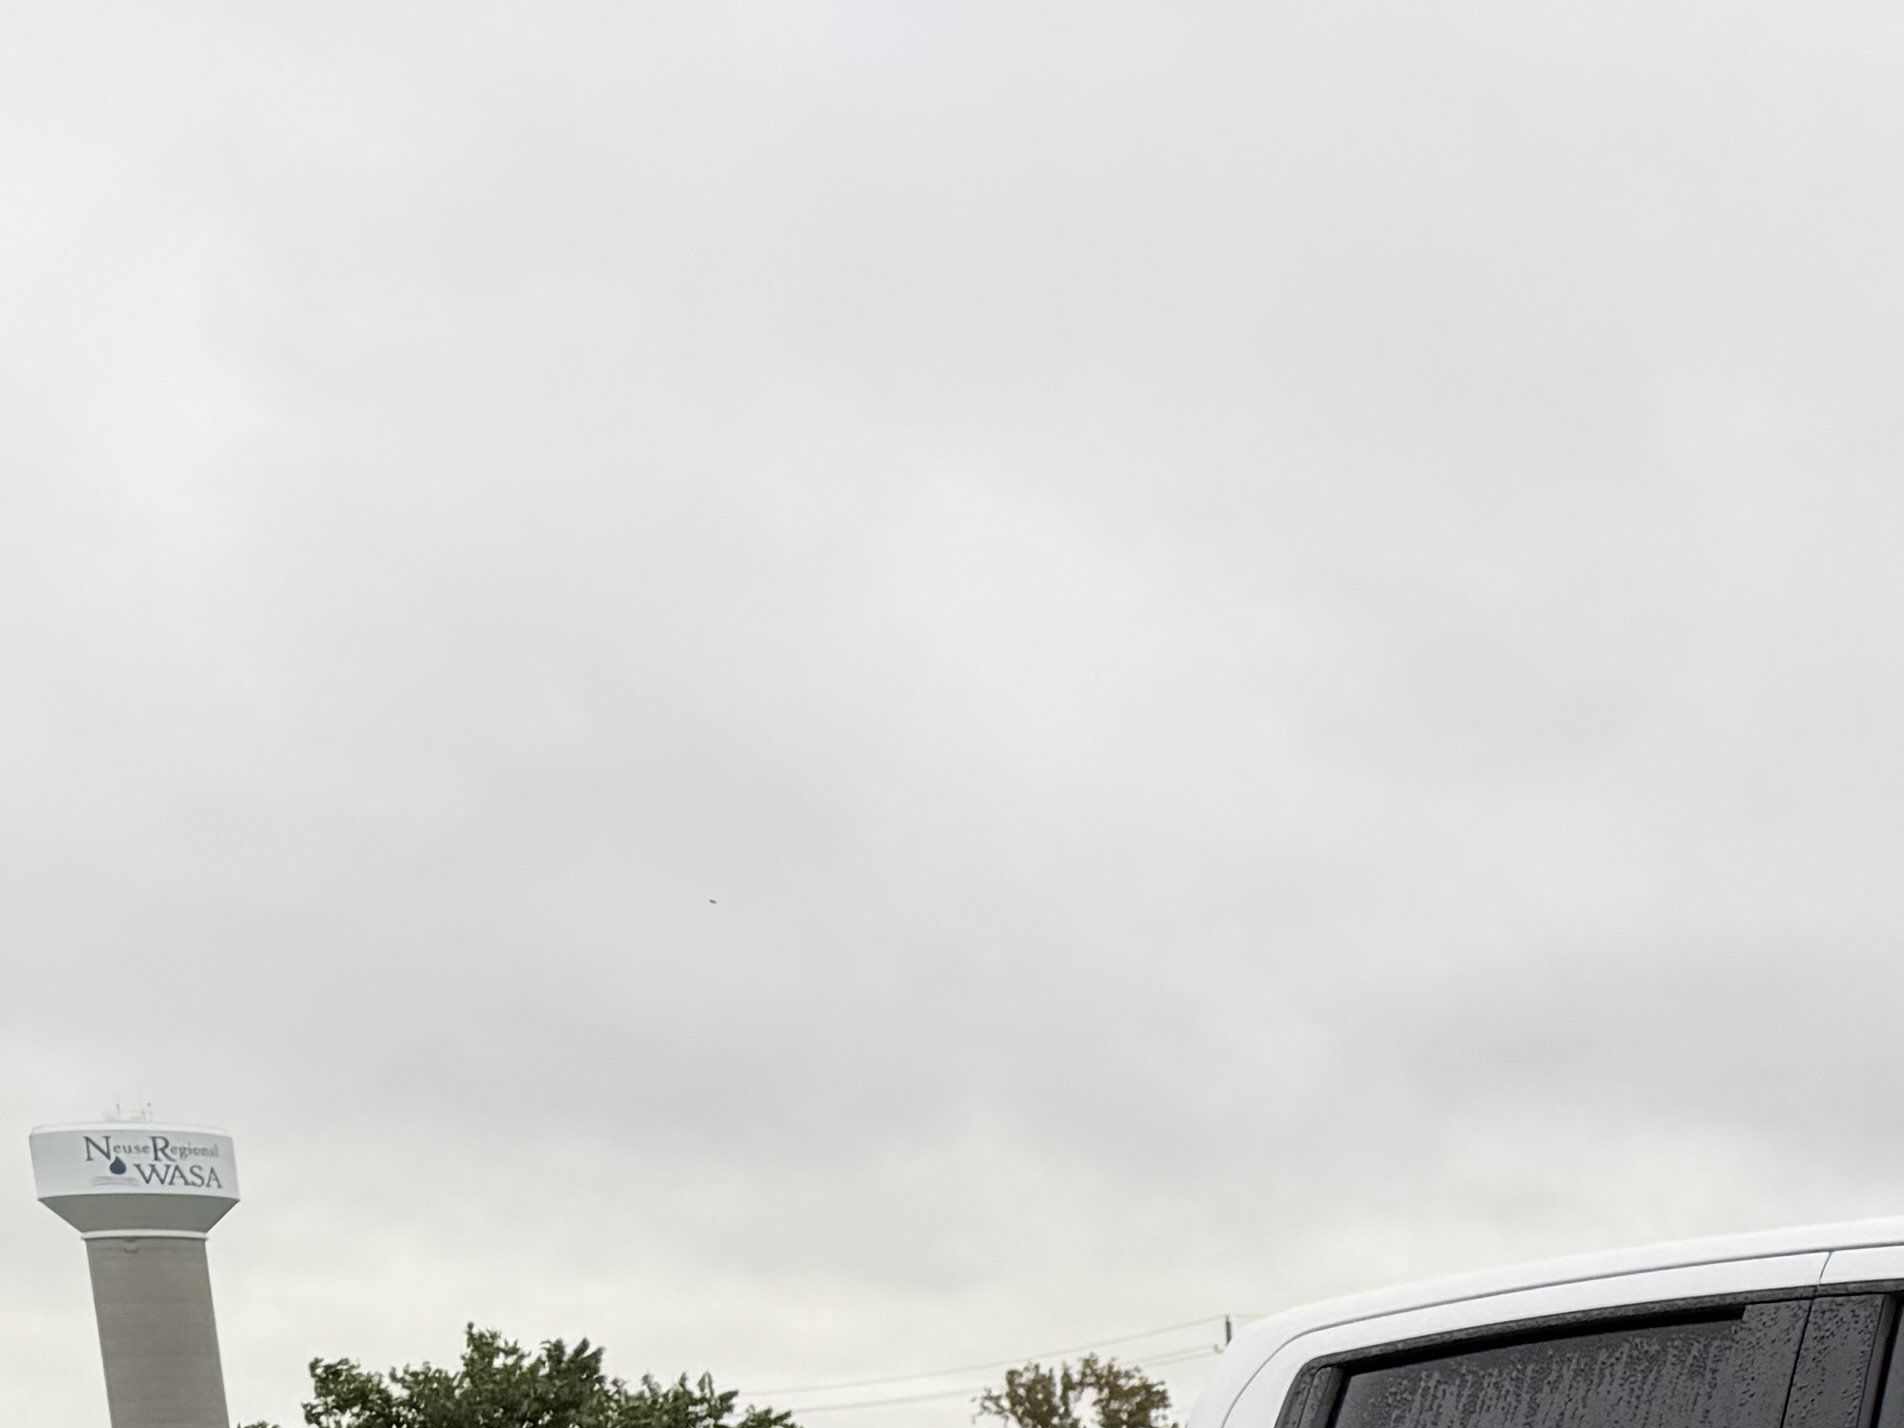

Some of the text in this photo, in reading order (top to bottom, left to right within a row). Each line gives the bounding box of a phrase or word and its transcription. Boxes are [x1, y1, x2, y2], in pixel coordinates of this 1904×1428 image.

[83, 1135, 220, 1162] Neuse Regional
[133, 1162, 223, 1189] WASA
